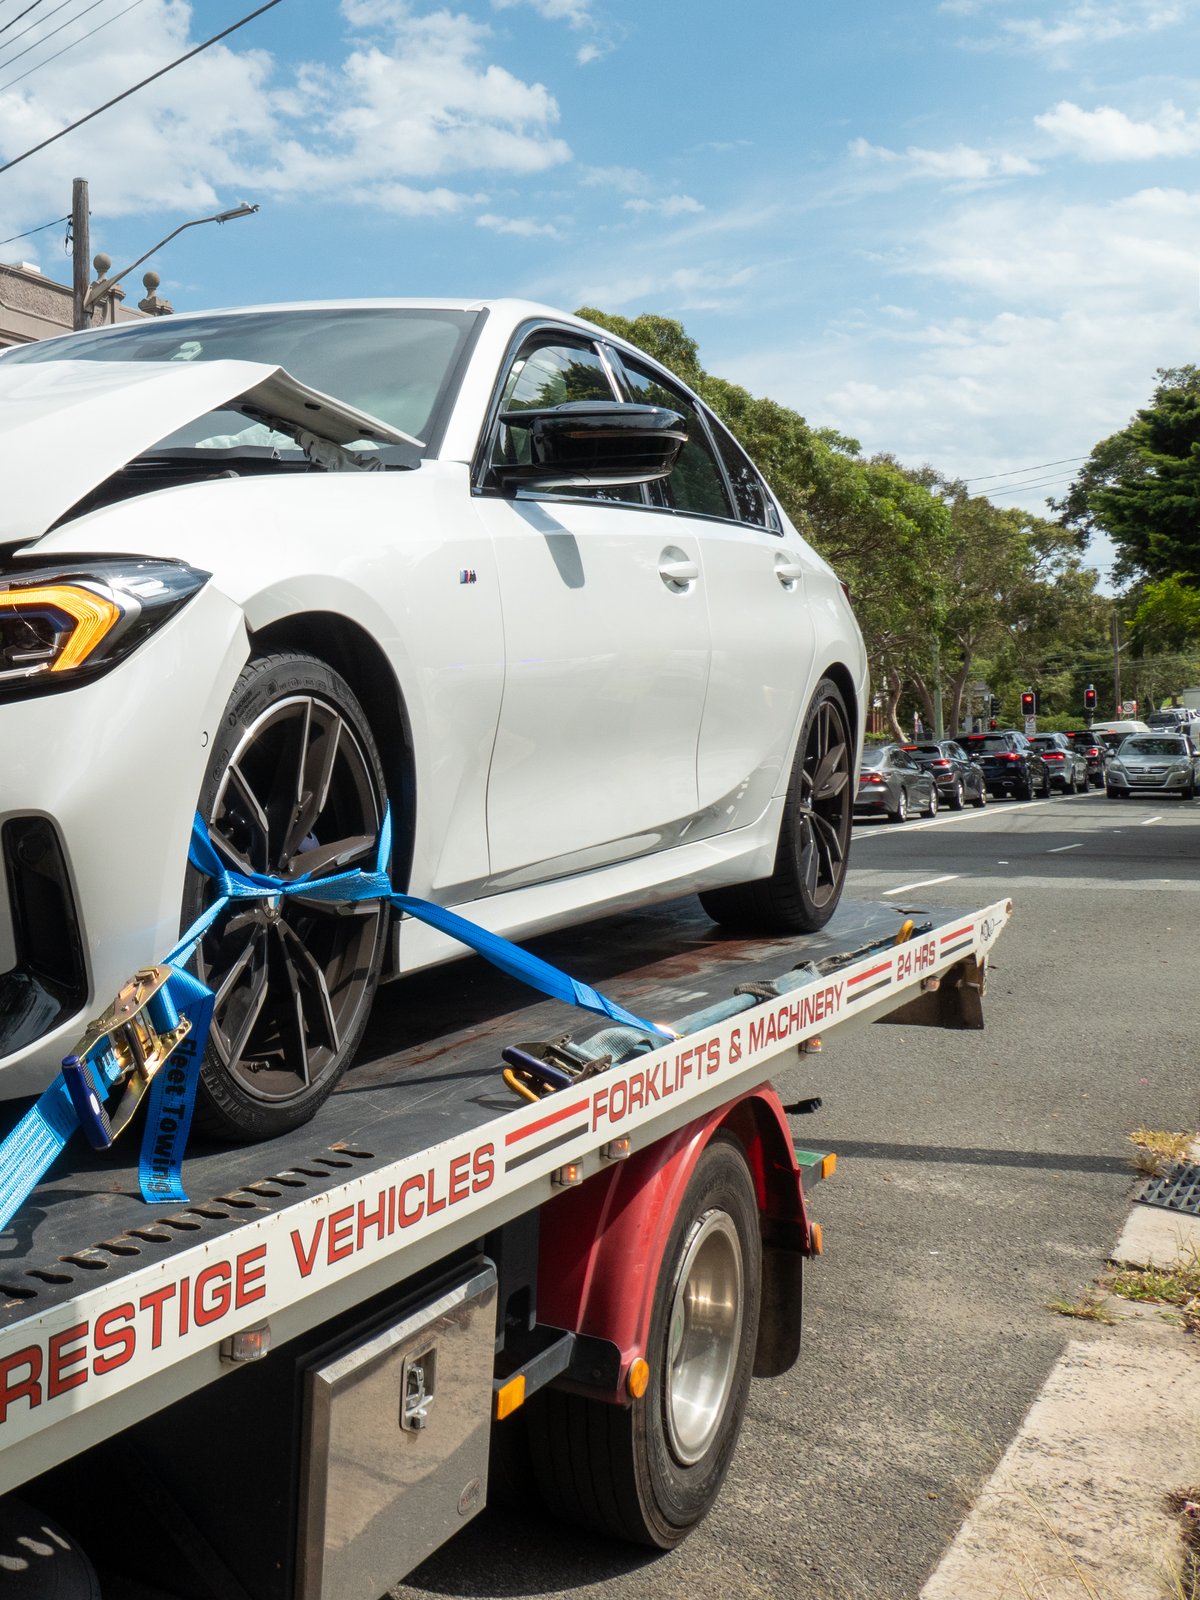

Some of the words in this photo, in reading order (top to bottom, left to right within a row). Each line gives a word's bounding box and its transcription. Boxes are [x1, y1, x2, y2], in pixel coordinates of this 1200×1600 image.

[165, 1038, 197, 1096] Fleet
[290, 1141, 496, 1278] VEHICLES
[592, 1037, 720, 1132] FORKLIFTS
[728, 1028, 742, 1064] &
[748, 981, 844, 1054] MACHINERY
[896, 952, 912, 981] 24
[913, 940, 936, 973] HRS
[147, 1103, 186, 1193] Towing
